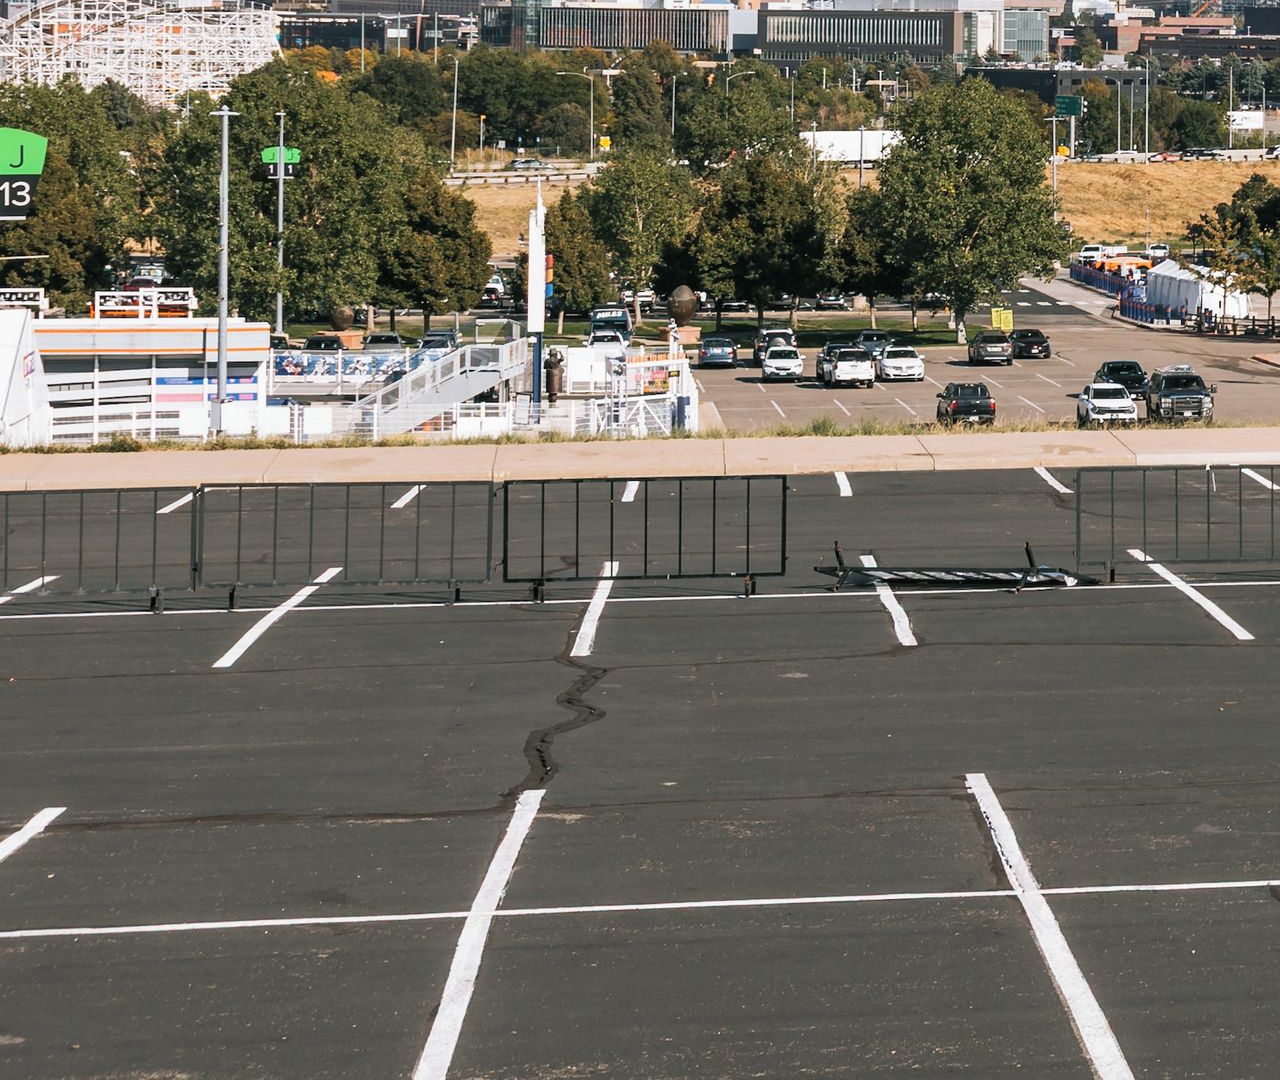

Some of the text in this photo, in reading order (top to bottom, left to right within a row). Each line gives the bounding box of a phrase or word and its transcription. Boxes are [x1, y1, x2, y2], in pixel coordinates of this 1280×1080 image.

[9, 145, 24, 168] J
[269, 152, 293, 161] J J
[268, 164, 274, 174] 1
[0, 181, 31, 207] 13
